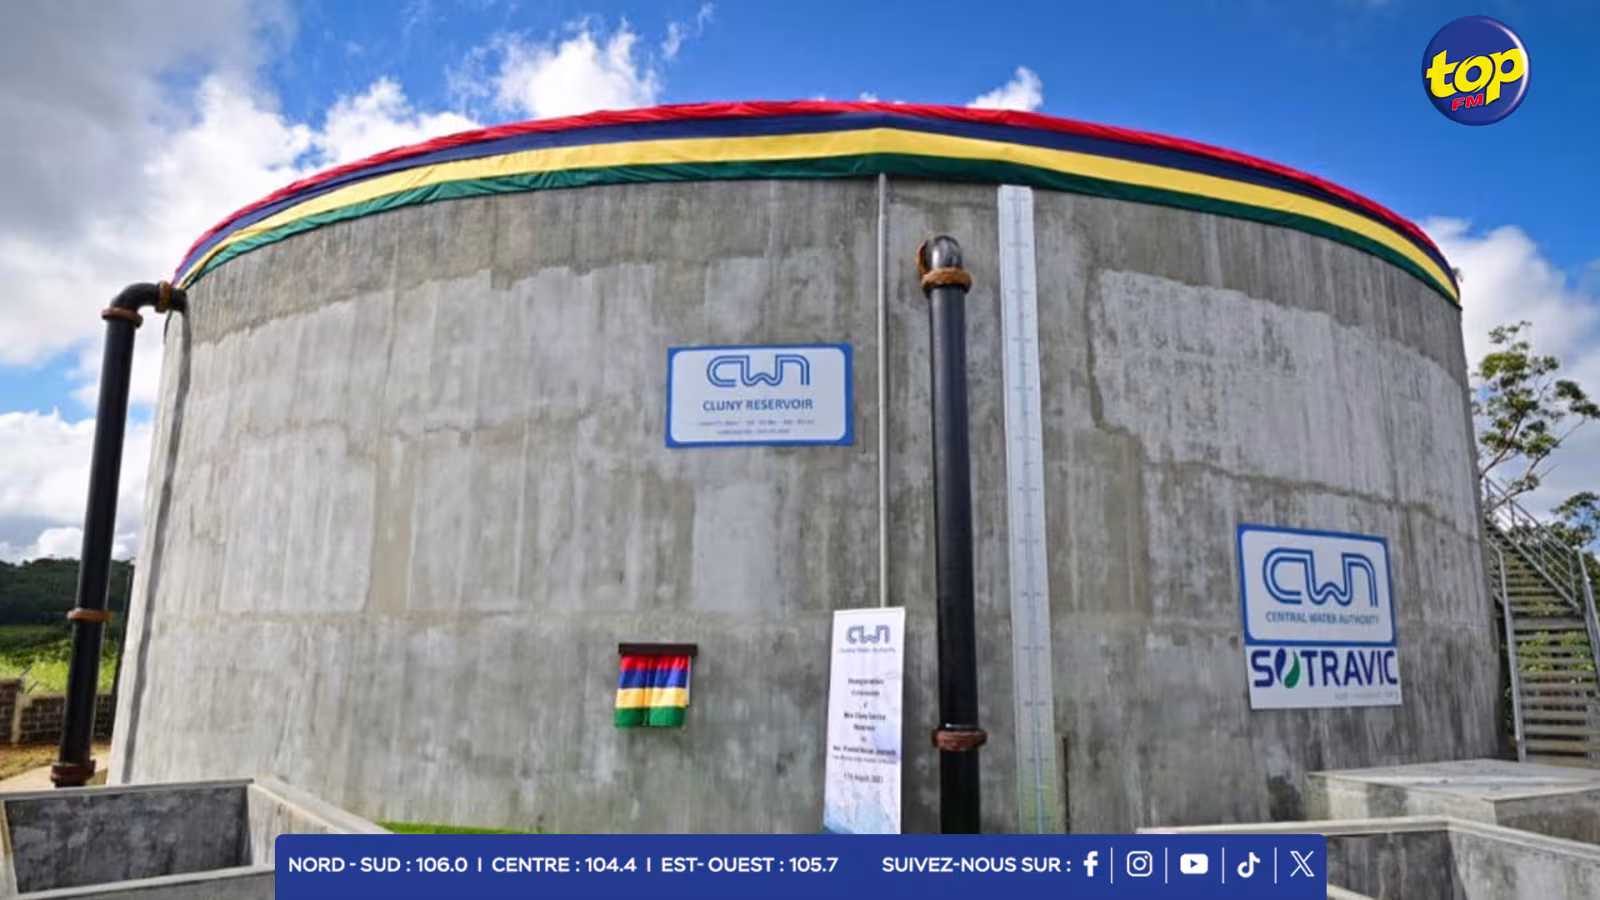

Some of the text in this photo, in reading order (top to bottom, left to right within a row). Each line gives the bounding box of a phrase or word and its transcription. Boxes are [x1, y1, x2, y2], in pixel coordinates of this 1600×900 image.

[702, 399, 814, 412] CLUNY RESERVOIR
[1265, 610, 1379, 626] CENTRAL WATER AUTHORITY
[1250, 648, 1399, 689] SOTRAVIC
